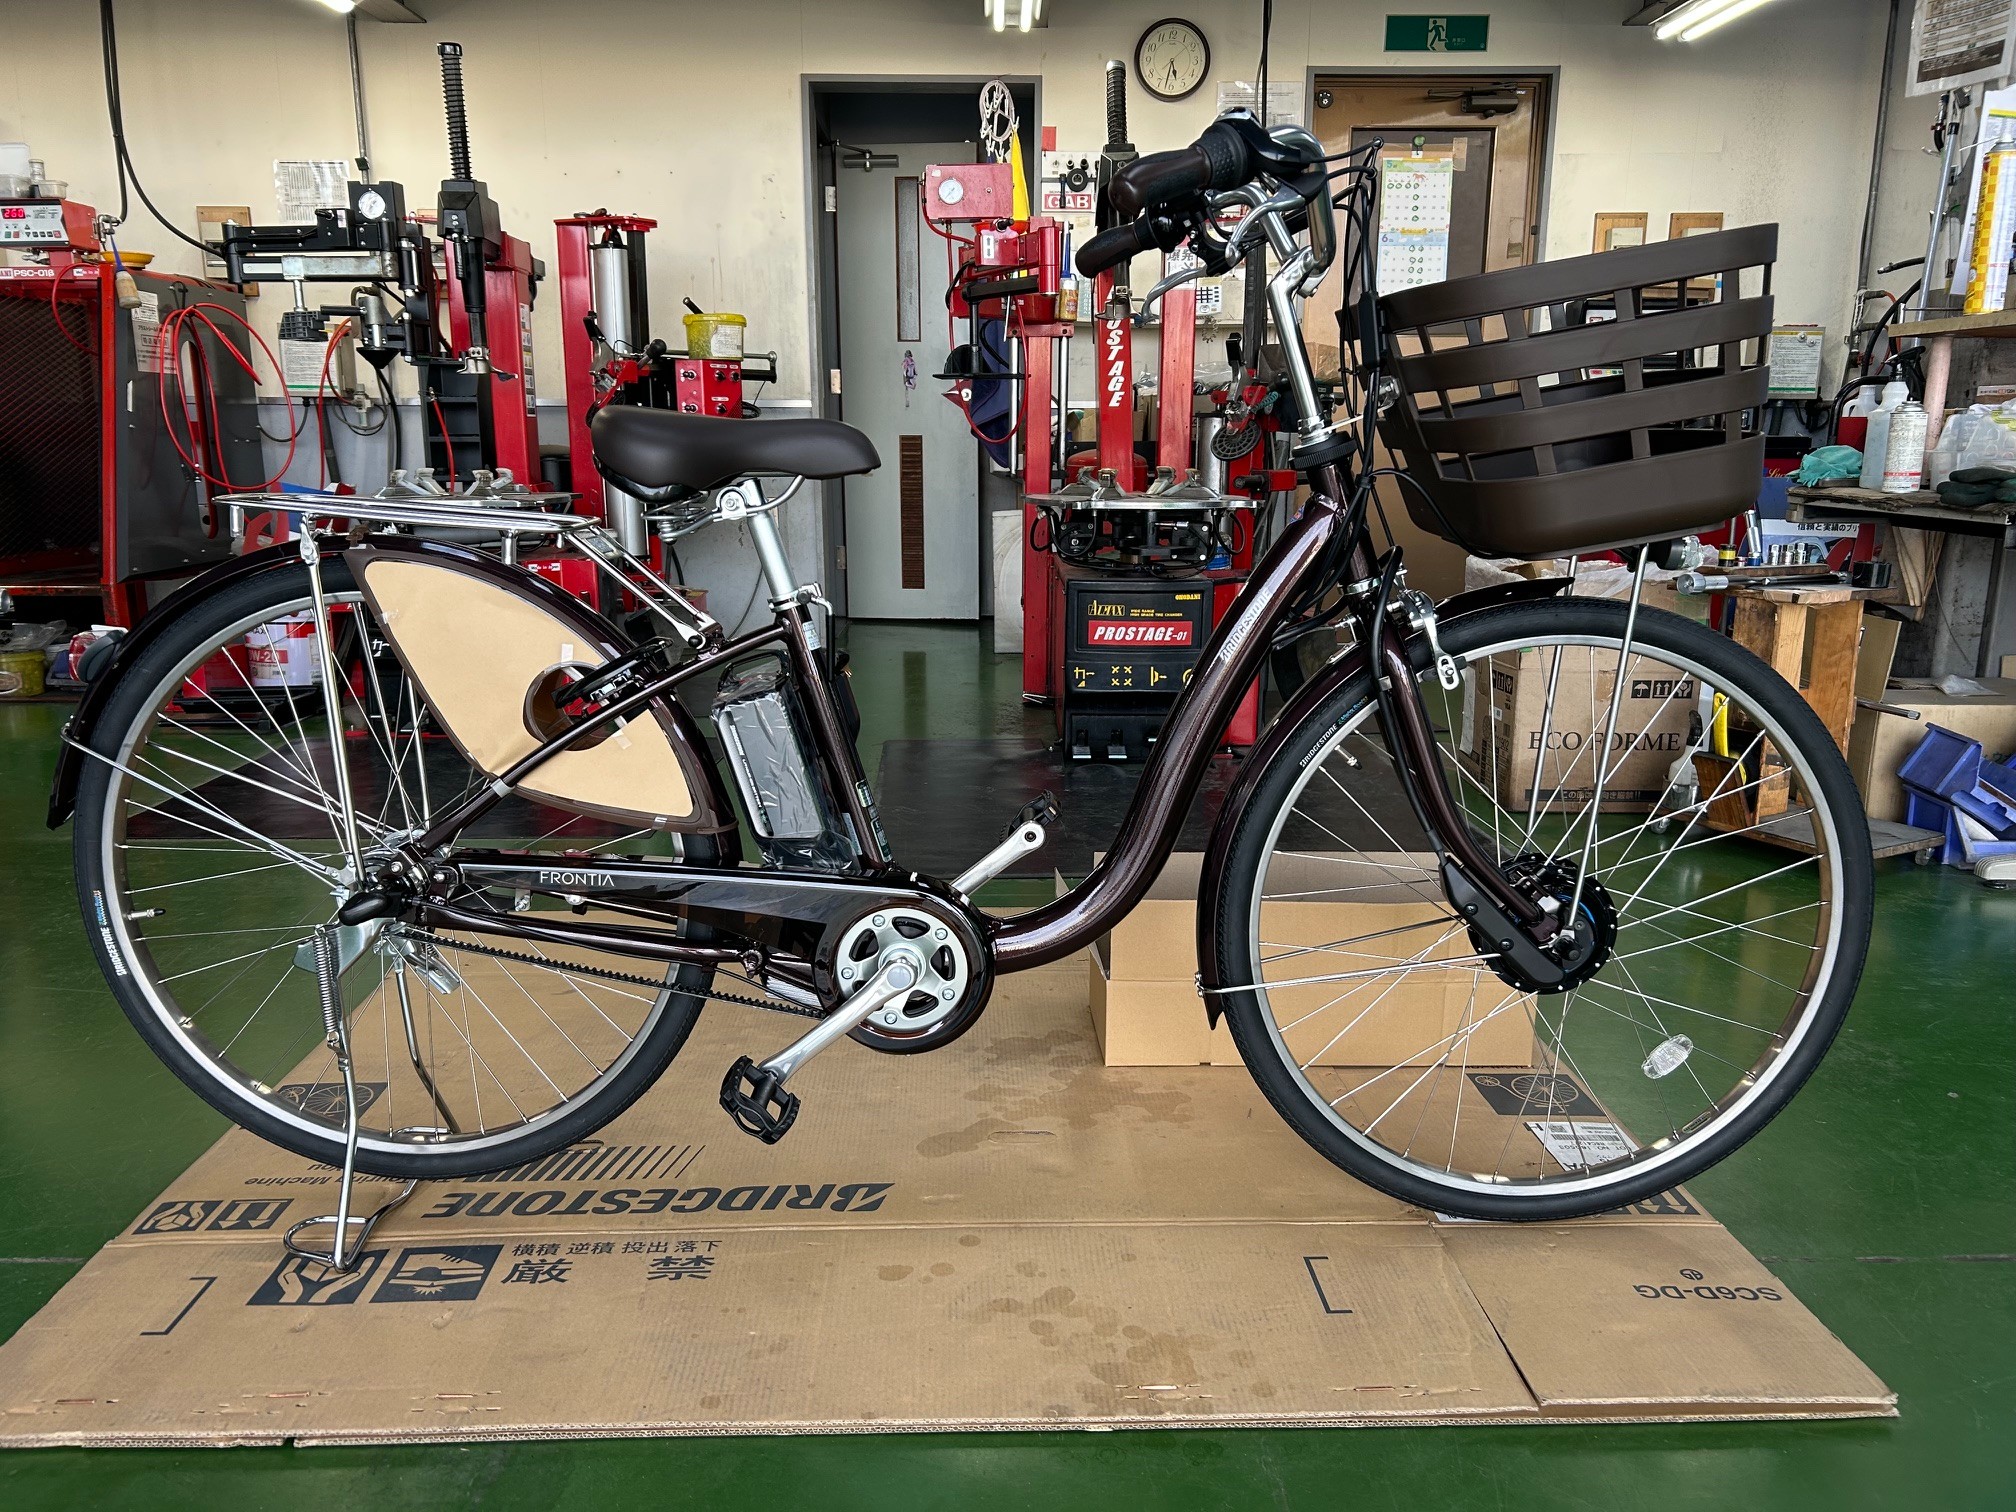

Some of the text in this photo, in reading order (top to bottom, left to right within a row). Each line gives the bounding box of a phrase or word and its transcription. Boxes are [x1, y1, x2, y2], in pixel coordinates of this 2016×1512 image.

[1157, 32, 1166, 42] 11
[1168, 29, 1178, 40] 12
[1182, 34, 1187, 43] 1
[1147, 42, 1157, 53] 10
[1189, 42, 1197, 52] 2
[1145, 56, 1152, 67] 9
[1192, 56, 1199, 66] 3
[1147, 68, 1155, 79] 8
[1188, 68, 1195, 78] 4
[1156, 77, 1163, 88] 7
[1168, 81, 1175, 91] 6
[1179, 78, 1186, 88] 5
[1386, 160, 1393, 169] 5
[4, 208, 24, 218] 260
[1381, 234, 1389, 243] 6
[1093, 626, 1188, 641] PROSTAGE-01
[1299, 723, 1338, 768] BRIDGESTONE
[1528, 731, 1583, 750] ECO
[1590, 731, 1681, 751] FORME
[540, 871, 615, 887] FRONTIA
[100, 927, 127, 976] BRIDGESTONE
[245, 1176, 332, 1186] Machine
[421, 1183, 895, 1219] BRIDGESTONE
[511, 1240, 722, 1256] 横積 逆積 投出 落下
[1633, 1285, 1783, 1301] SC6D-DG
